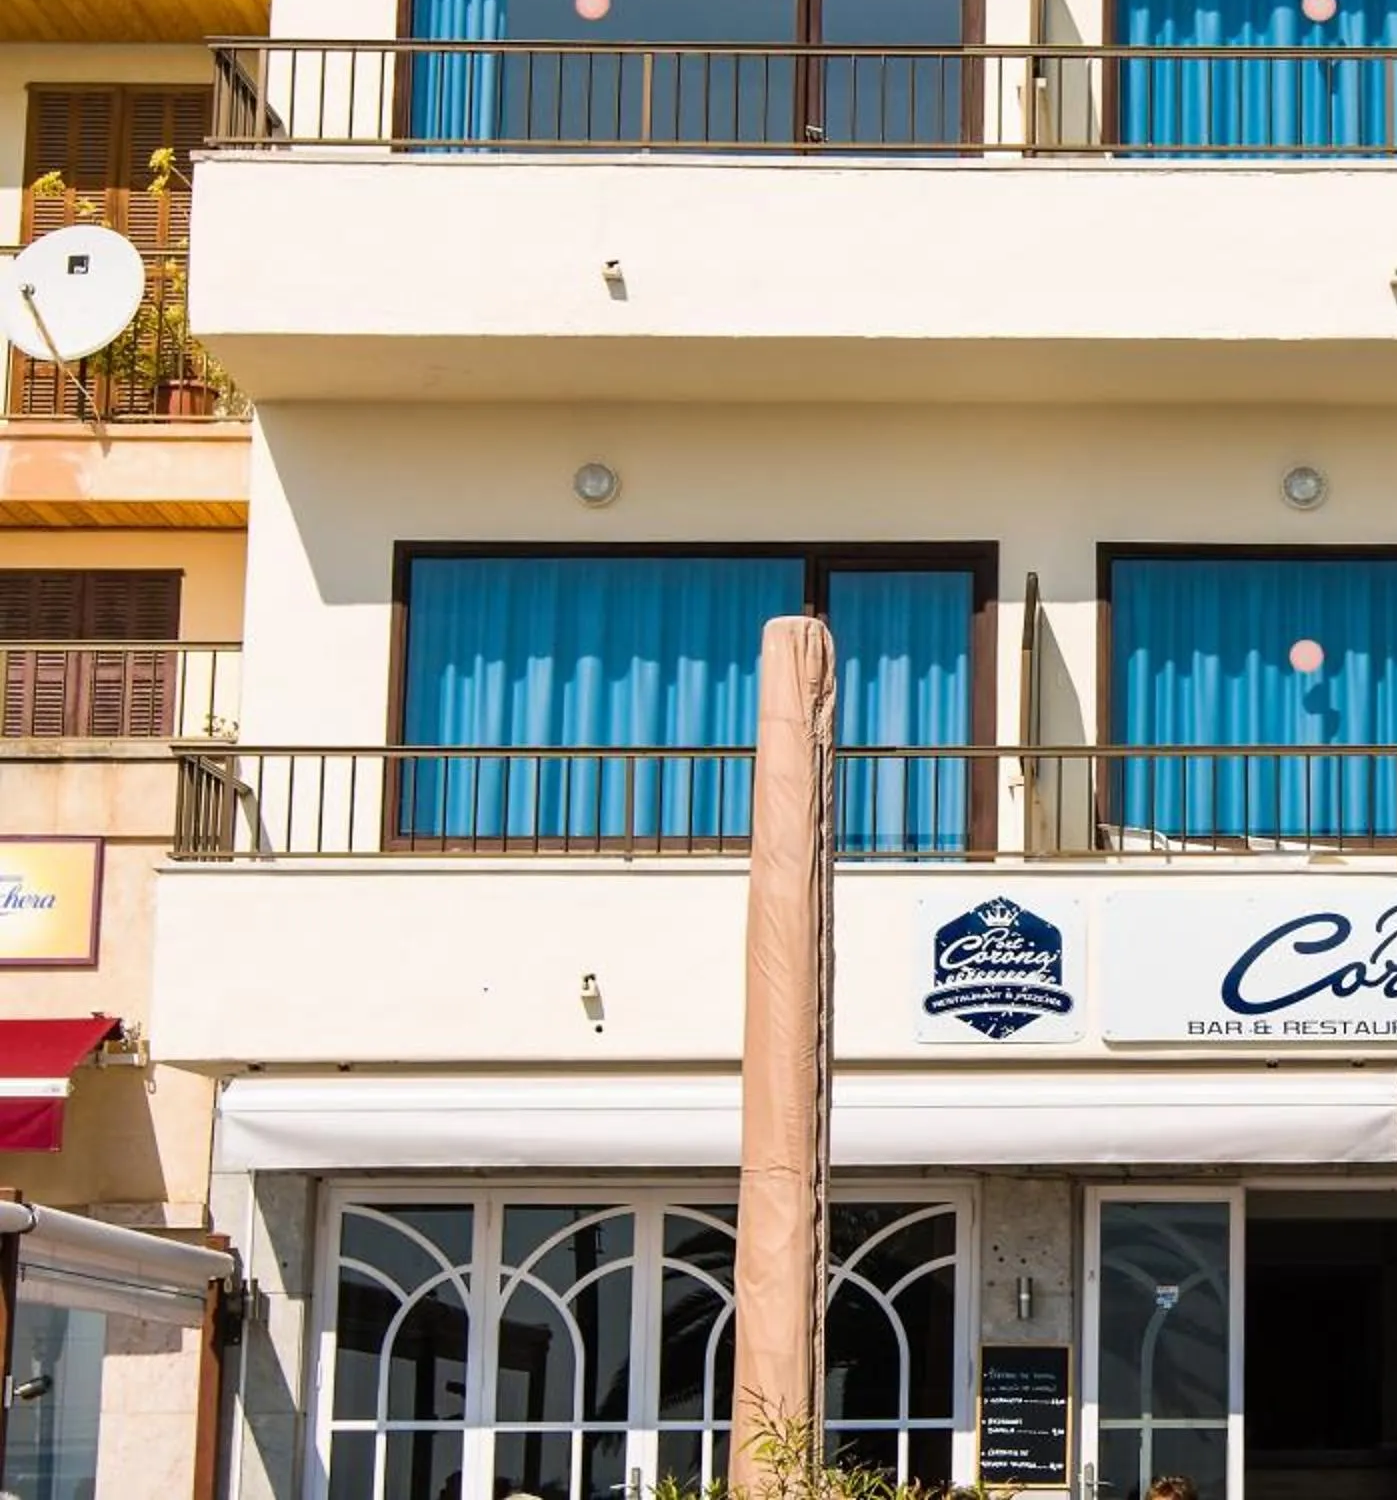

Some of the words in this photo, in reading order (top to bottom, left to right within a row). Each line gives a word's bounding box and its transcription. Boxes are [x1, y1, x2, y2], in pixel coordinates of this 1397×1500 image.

[0, 883, 56, 909] hera
[939, 935, 1058, 971] Corona
[1187, 1020, 1243, 1035] BAR
[1251, 1019, 1273, 1035] &
